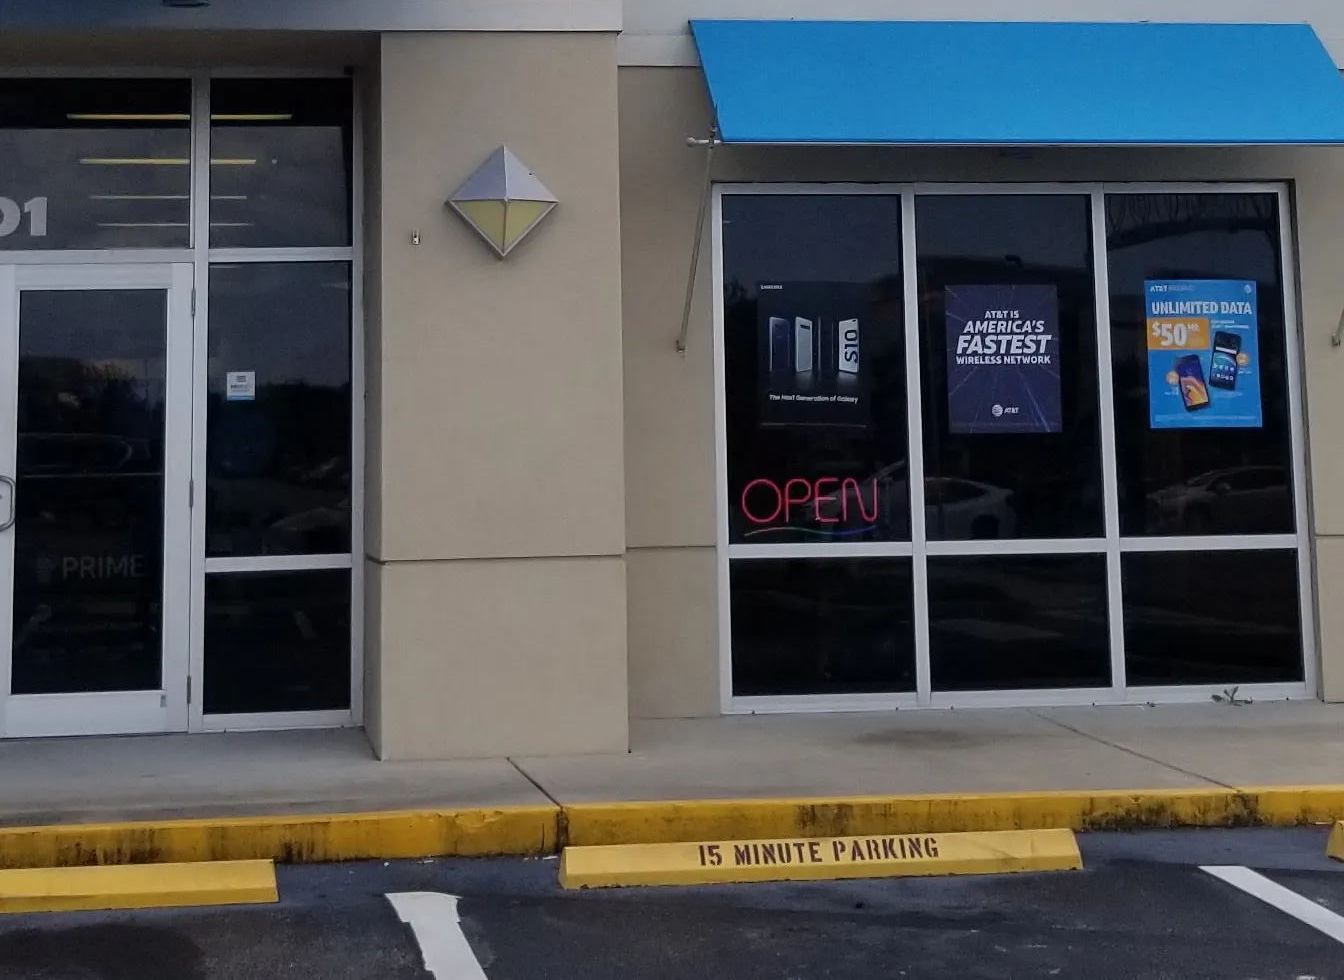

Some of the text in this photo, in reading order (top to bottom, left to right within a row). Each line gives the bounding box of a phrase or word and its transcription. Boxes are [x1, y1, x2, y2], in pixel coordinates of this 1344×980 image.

[984, 310, 1020, 319] AT&T IS
[1151, 301, 1253, 315] UNLIMITED DATA
[963, 320, 1045, 333] AMERICA'S
[1151, 320, 1188, 347] $50
[844, 329, 858, 364] S10
[956, 334, 1053, 354] FASTEST
[956, 355, 1052, 365] WIRELESS NETWORK
[741, 477, 879, 523] OPEN
[62, 554, 148, 579] PRIME
[698, 837, 939, 866] 15 MINUTE PARKING
